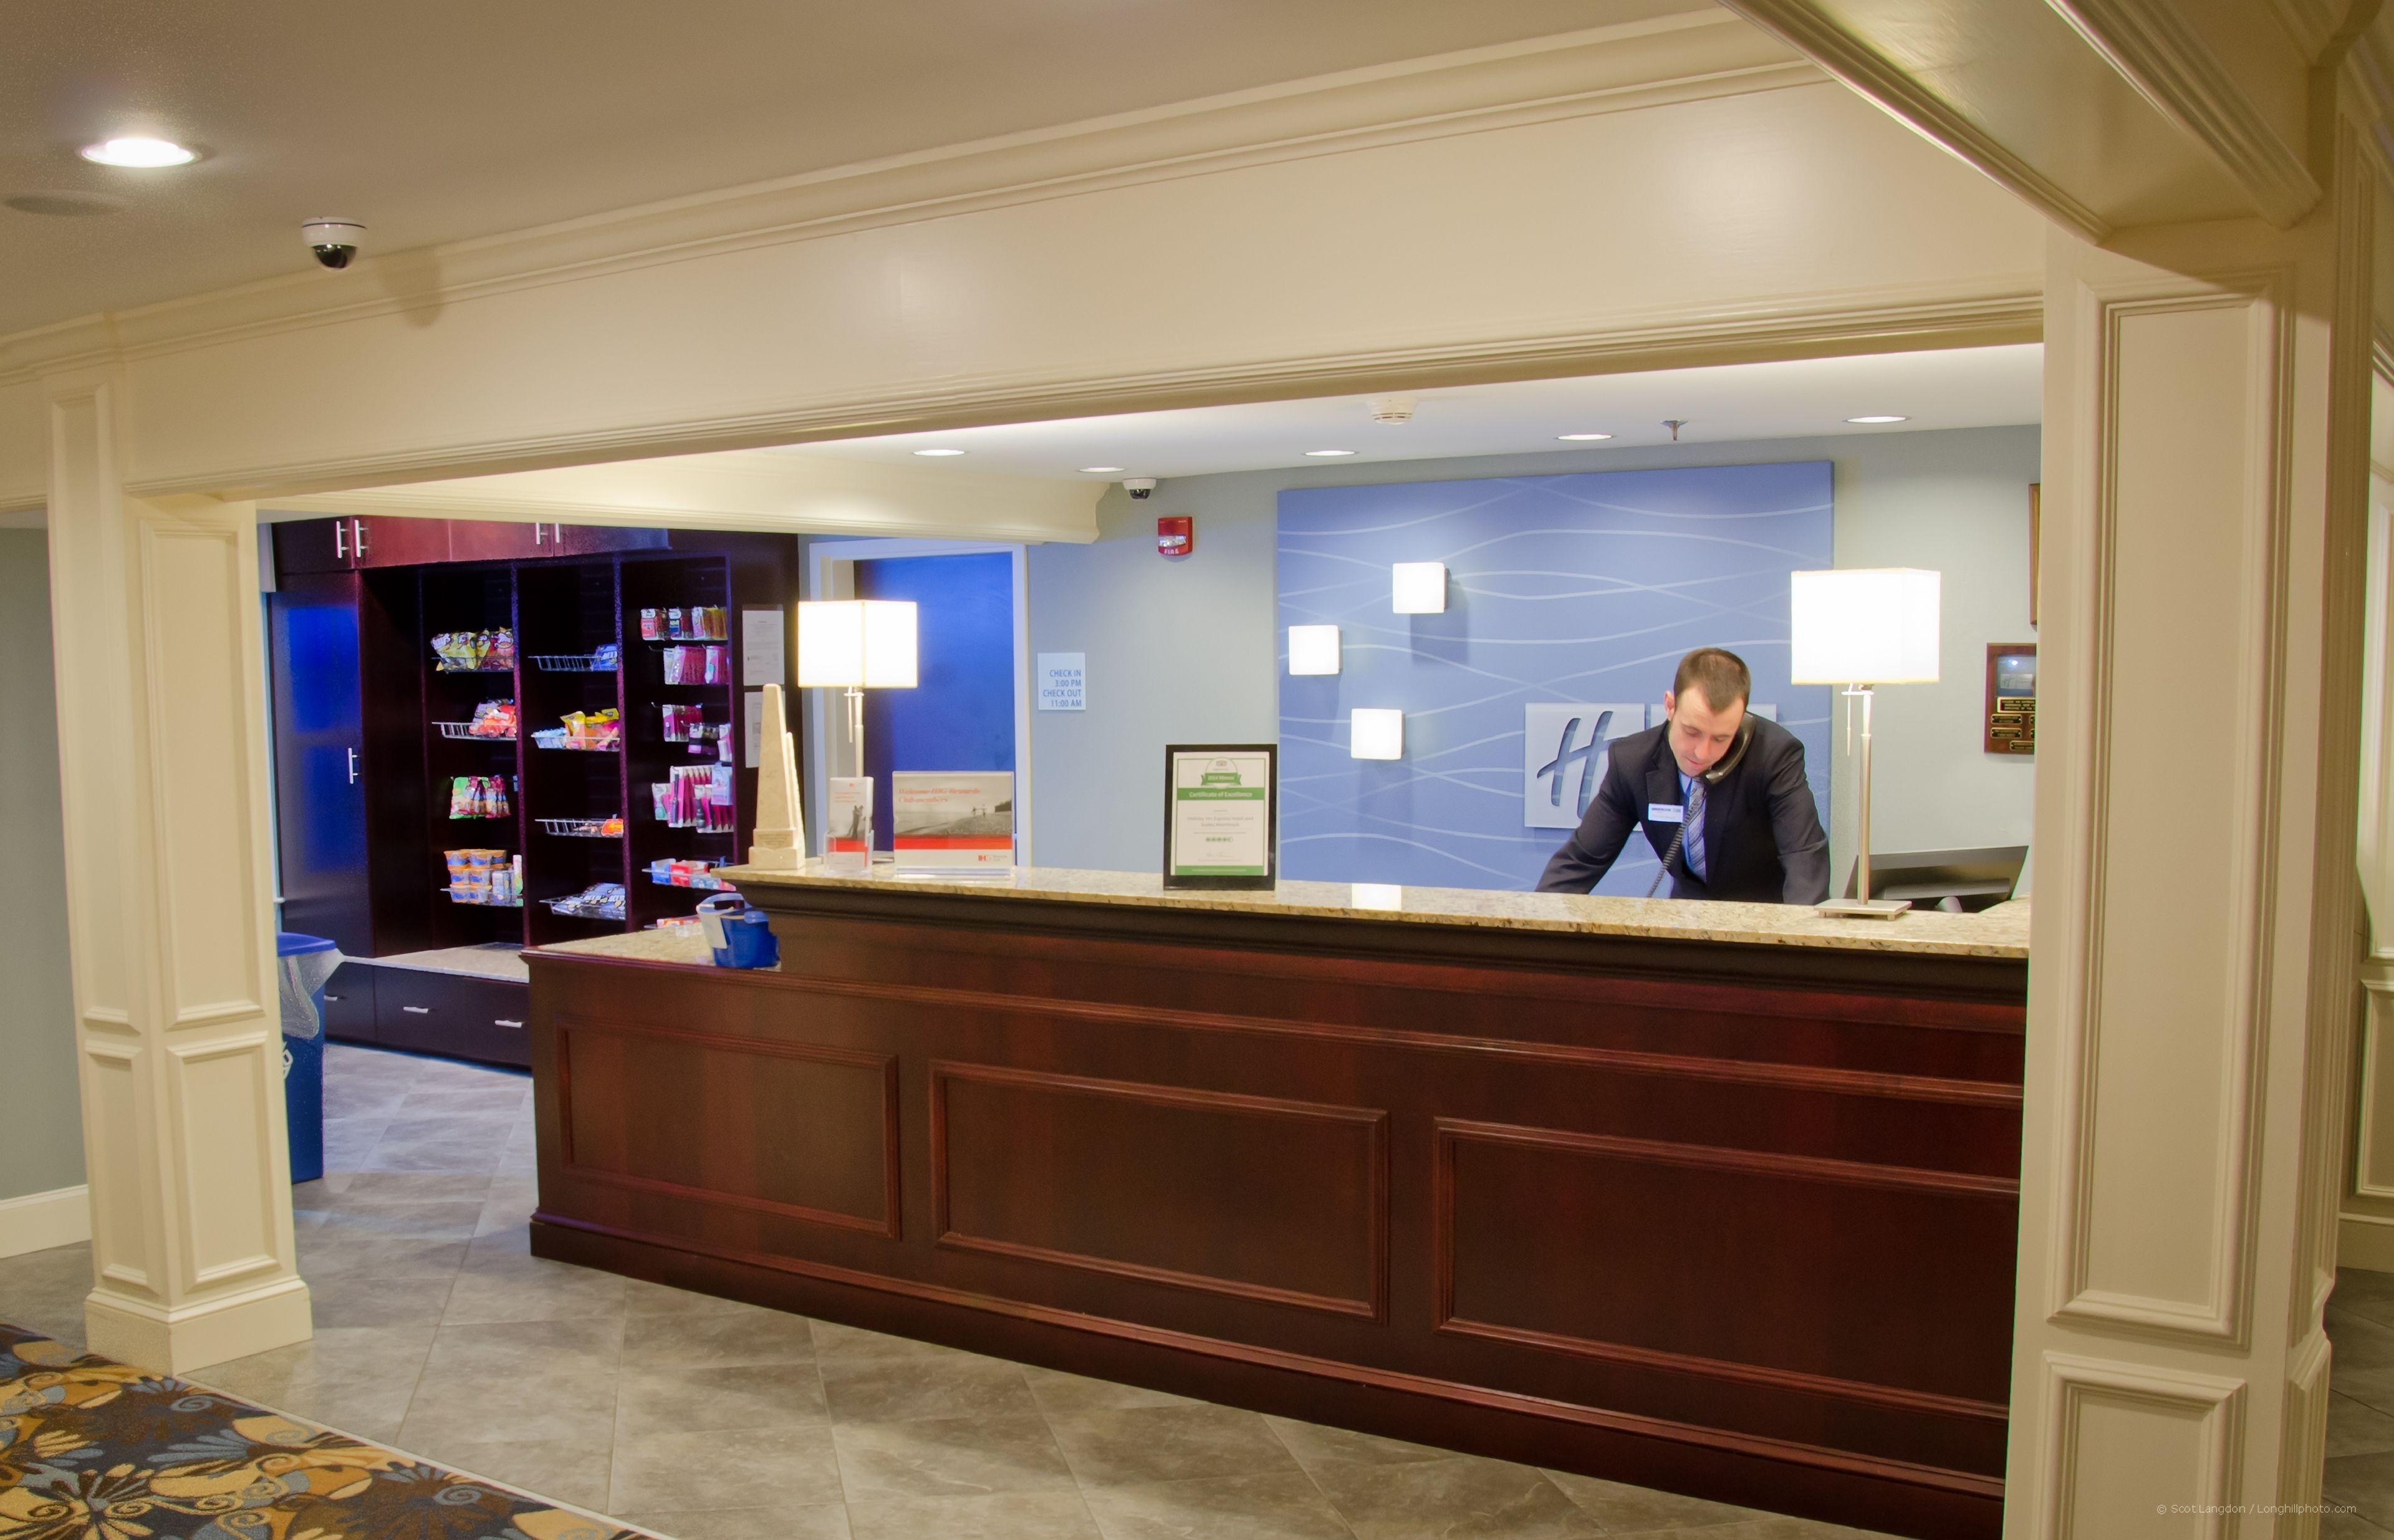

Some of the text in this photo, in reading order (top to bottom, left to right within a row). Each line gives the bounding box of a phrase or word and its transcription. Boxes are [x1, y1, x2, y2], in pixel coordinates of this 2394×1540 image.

[1049, 669, 1081, 677] CHECK IN
[1042, 689, 1082, 697] CHECK OUT
